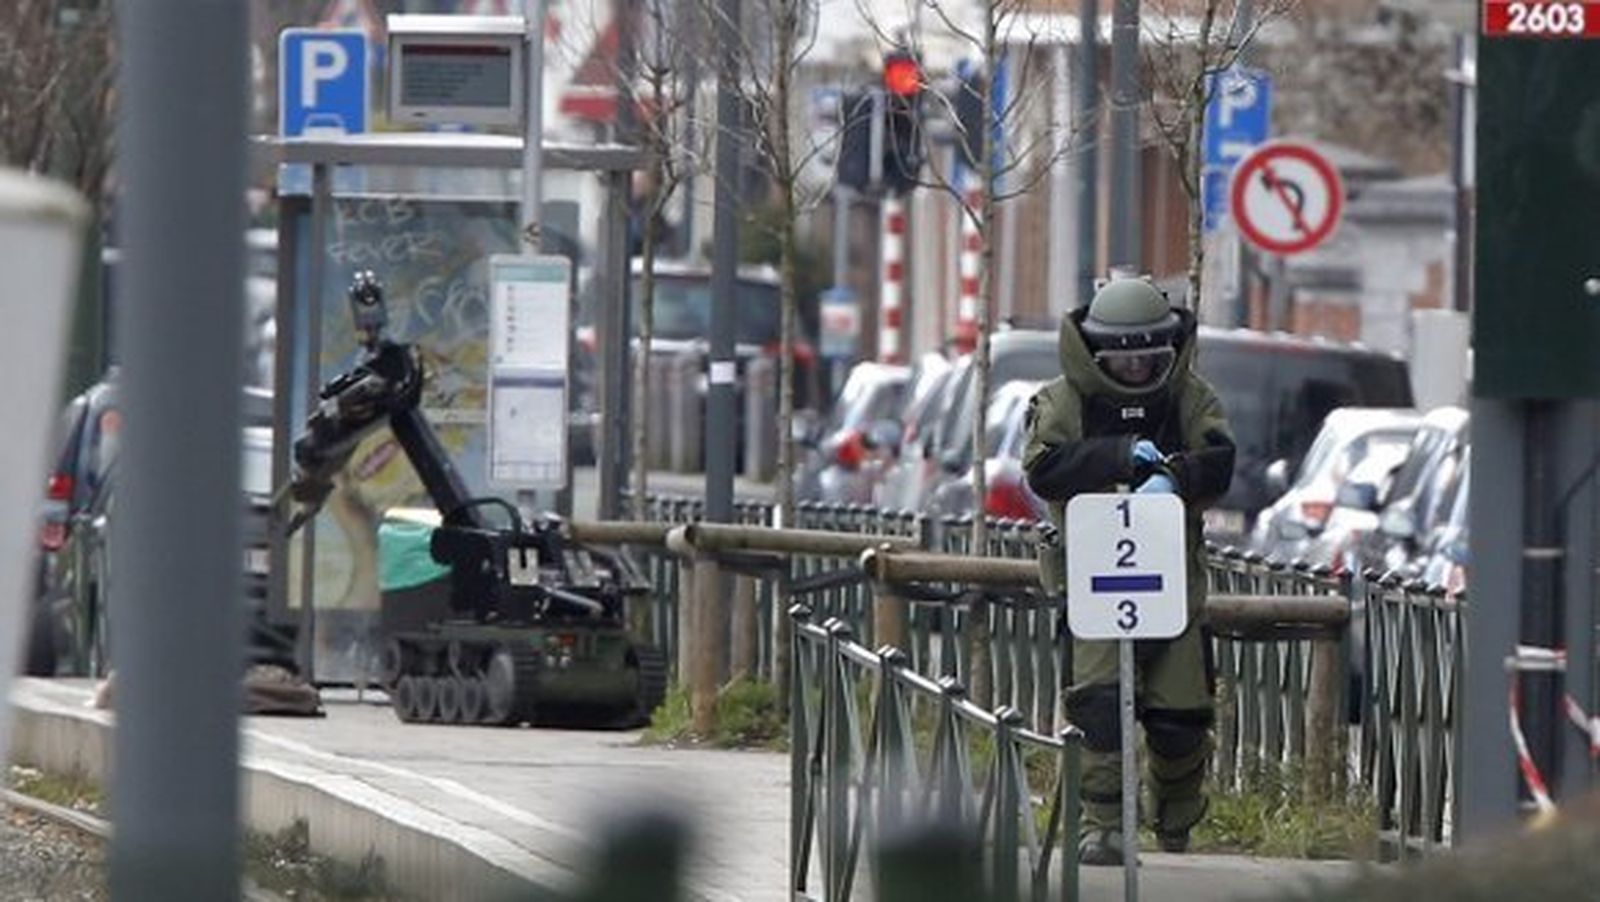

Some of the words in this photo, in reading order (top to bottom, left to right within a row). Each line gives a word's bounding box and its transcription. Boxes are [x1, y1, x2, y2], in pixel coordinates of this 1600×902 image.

[1507, 2, 1585, 34] 2603
[301, 39, 348, 108] P
[1218, 76, 1258, 128] P
[1116, 500, 1131, 528] 1
[1116, 539, 1137, 568] 2
[1116, 600, 1138, 631] 3
